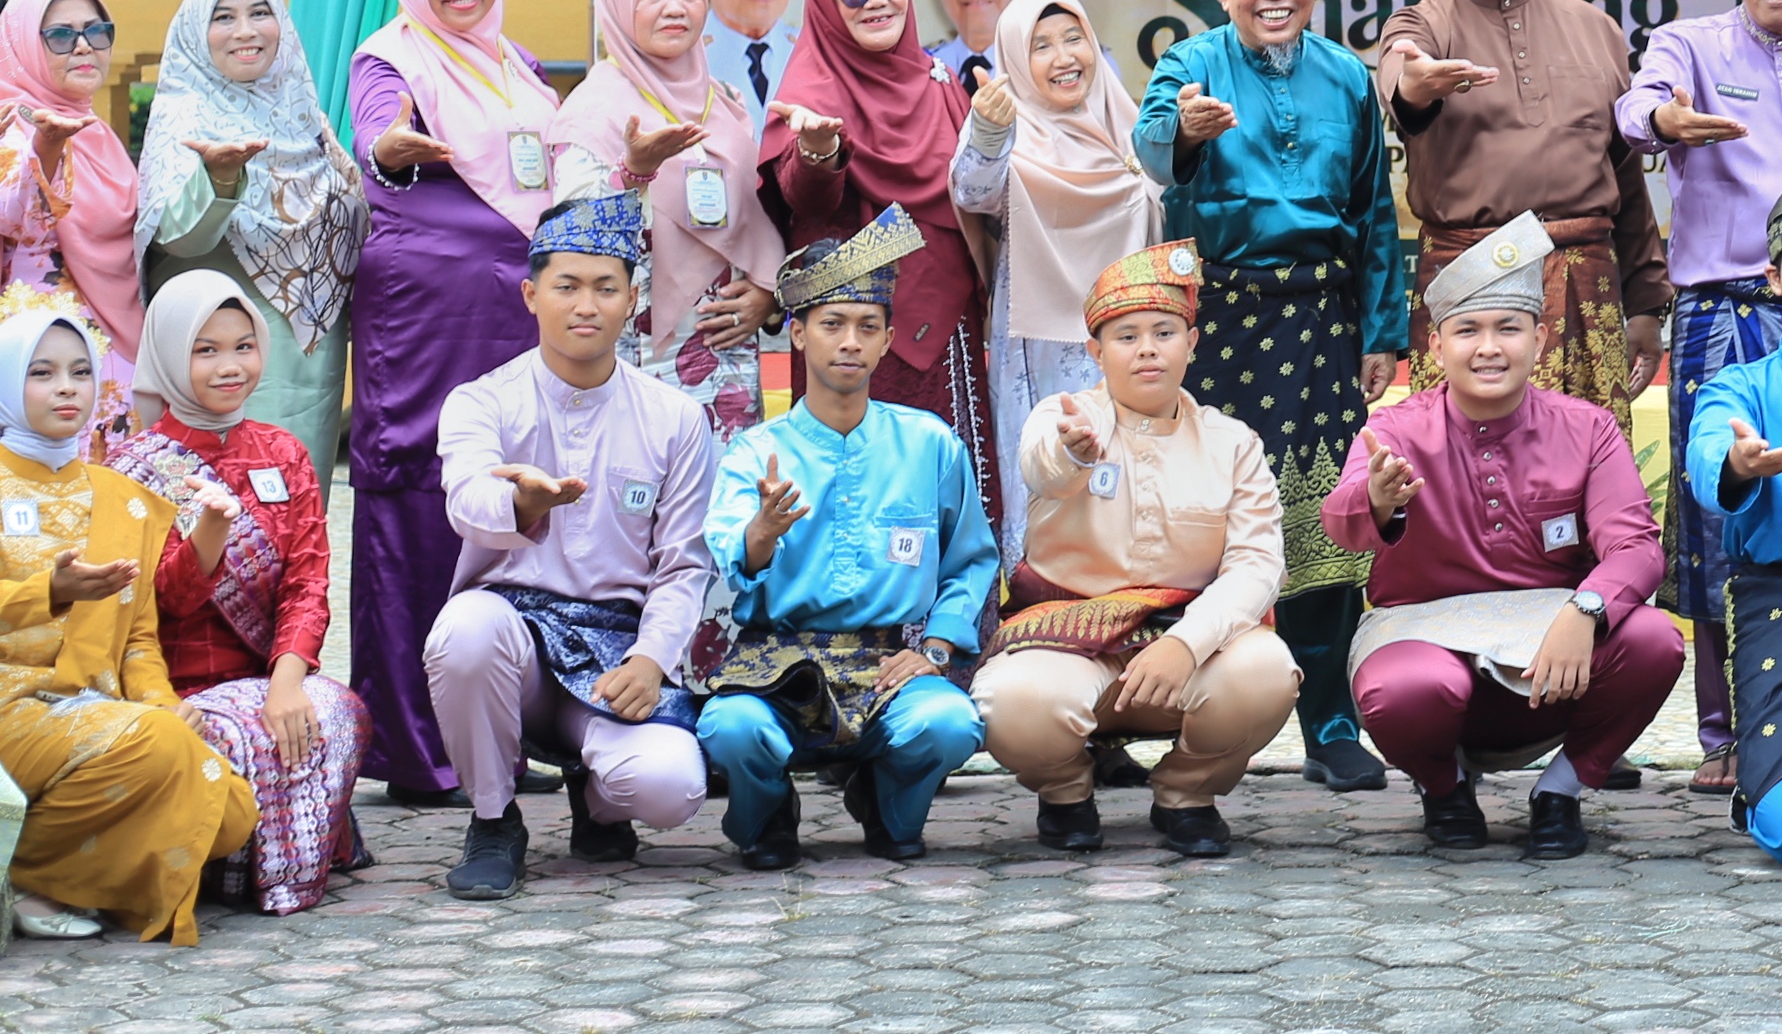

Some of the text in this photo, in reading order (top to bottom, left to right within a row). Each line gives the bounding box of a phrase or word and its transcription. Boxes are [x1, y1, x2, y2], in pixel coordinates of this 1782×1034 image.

[1099, 472, 1108, 486] 6
[261, 479, 276, 494] 13
[631, 490, 645, 504] 10
[14, 510, 29, 525] 11
[1555, 526, 1565, 540] 2
[899, 538, 913, 552] 18
